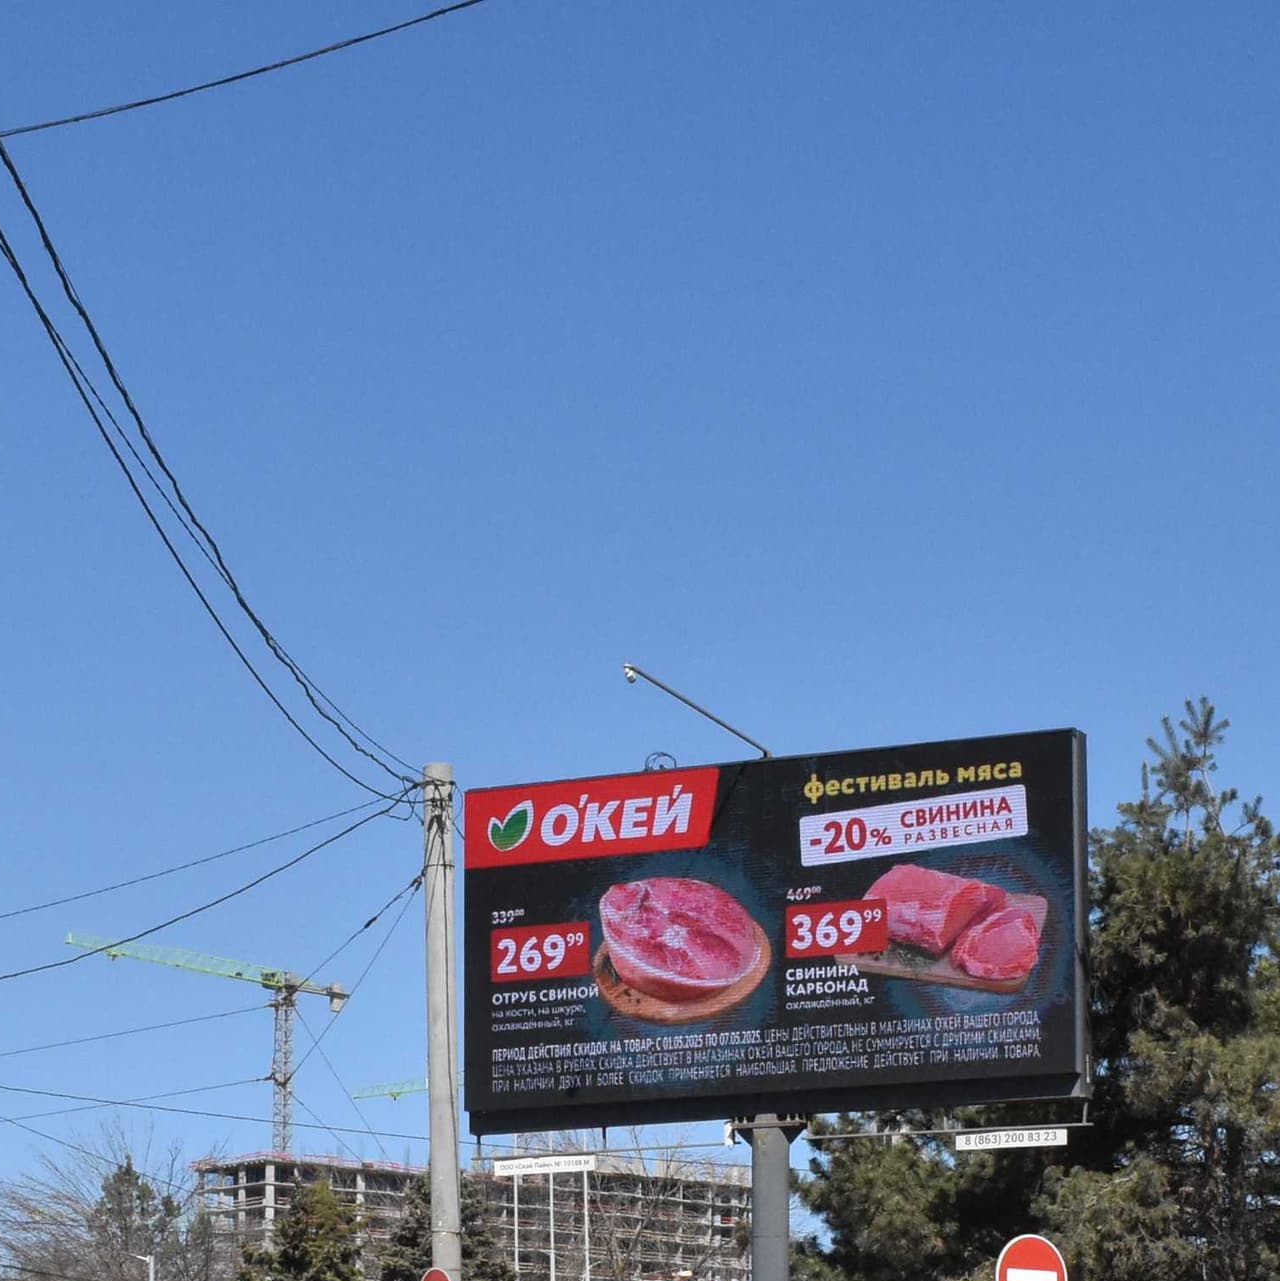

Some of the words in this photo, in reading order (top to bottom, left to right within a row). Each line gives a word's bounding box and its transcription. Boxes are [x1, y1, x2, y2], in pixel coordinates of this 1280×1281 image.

[803, 768, 950, 804] фестиваль
[957, 761, 1023, 783] мяса
[900, 796, 1013, 829] СВИНИНА
[904, 818, 1014, 844] РАЗВЕСНАЯ
[786, 964, 859, 980] СВИНИНА
[492, 991, 537, 1006] ОТРУБ
[539, 983, 599, 1001] СВИНОЙ
[786, 978, 869, 997] КАРБОНАД
[492, 1047, 526, 1062] ПЕРИОД
[527, 1043, 572, 1060] ДЕЙСТВИЯ
[573, 1041, 608, 1057] СКИДОК
[610, 1040, 622, 1053] НА
[965, 1136, 971, 1146] 8
[974, 1134, 1002, 1147] (863)
[1005, 1132, 1024, 1143] 200
[1028, 1132, 1040, 1142] 83
[1044, 1131, 1057, 1141] 23
